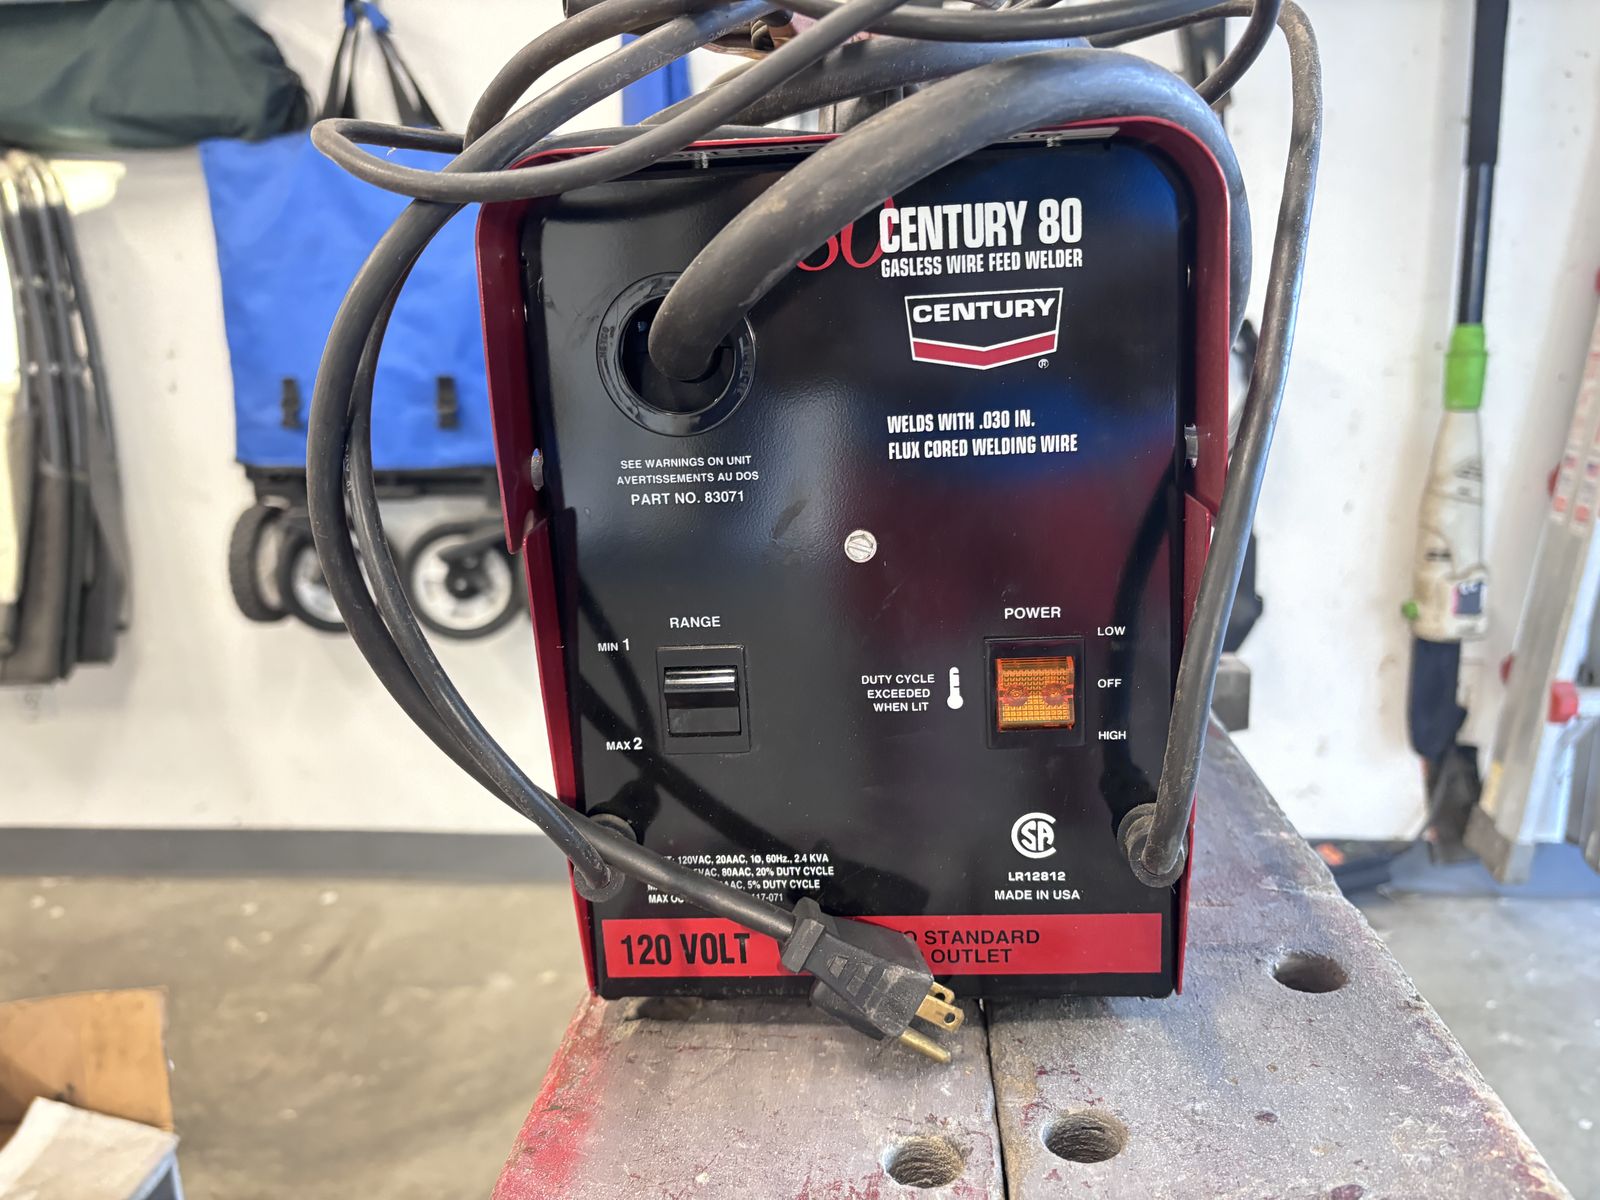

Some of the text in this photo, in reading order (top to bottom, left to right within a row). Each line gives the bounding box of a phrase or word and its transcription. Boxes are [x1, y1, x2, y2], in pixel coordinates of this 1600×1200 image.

[879, 198, 1082, 253] CENTURY 80
[881, 249, 1082, 277] GASLESS WIRE FEED WELDER
[912, 298, 1056, 323] CENTURY
[887, 410, 1035, 433] WELDS WITH .030 IN.
[889, 434, 1077, 459] FLUX CORED WELDING WIRE
[621, 456, 751, 469] SEE WARNINGS ON UNIT
[617, 471, 759, 485] AVERTISSEMENTS AU DOS
[631, 491, 743, 505] PART NO. 83071
[1005, 607, 1061, 619] POWER
[670, 616, 720, 628] RANGE
[1098, 626, 1125, 635] LOW
[598, 638, 631, 651] MIN 1
[862, 674, 935, 684] DUTY CYCLE
[1098, 679, 1121, 688] OFF
[868, 689, 930, 698] EXCEEDED
[873, 702, 929, 711] WHEN LIT
[1099, 731, 1126, 740] HIGH
[606, 737, 642, 750] MAX 2
[678, 855, 713, 864] 120VAC,
[716, 854, 747, 864] 20AAC,
[794, 854, 807, 862] 2.4
[810, 854, 829, 862] KVA
[694, 866, 834, 877] VAC, 80AAC, 20% DUTY CYCLE
[1009, 872, 1065, 881] LR12812
[748, 880, 761, 889] 5%
[763, 880, 787, 888] DUTY
[790, 880, 820, 888] CYCLE
[649, 894, 668, 903] MAX
[995, 890, 1080, 900] MADE IN USA
[924, 929, 1040, 945] STANDARD
[620, 932, 751, 965] 120 VOLT
[931, 948, 1012, 964] OUTLET
